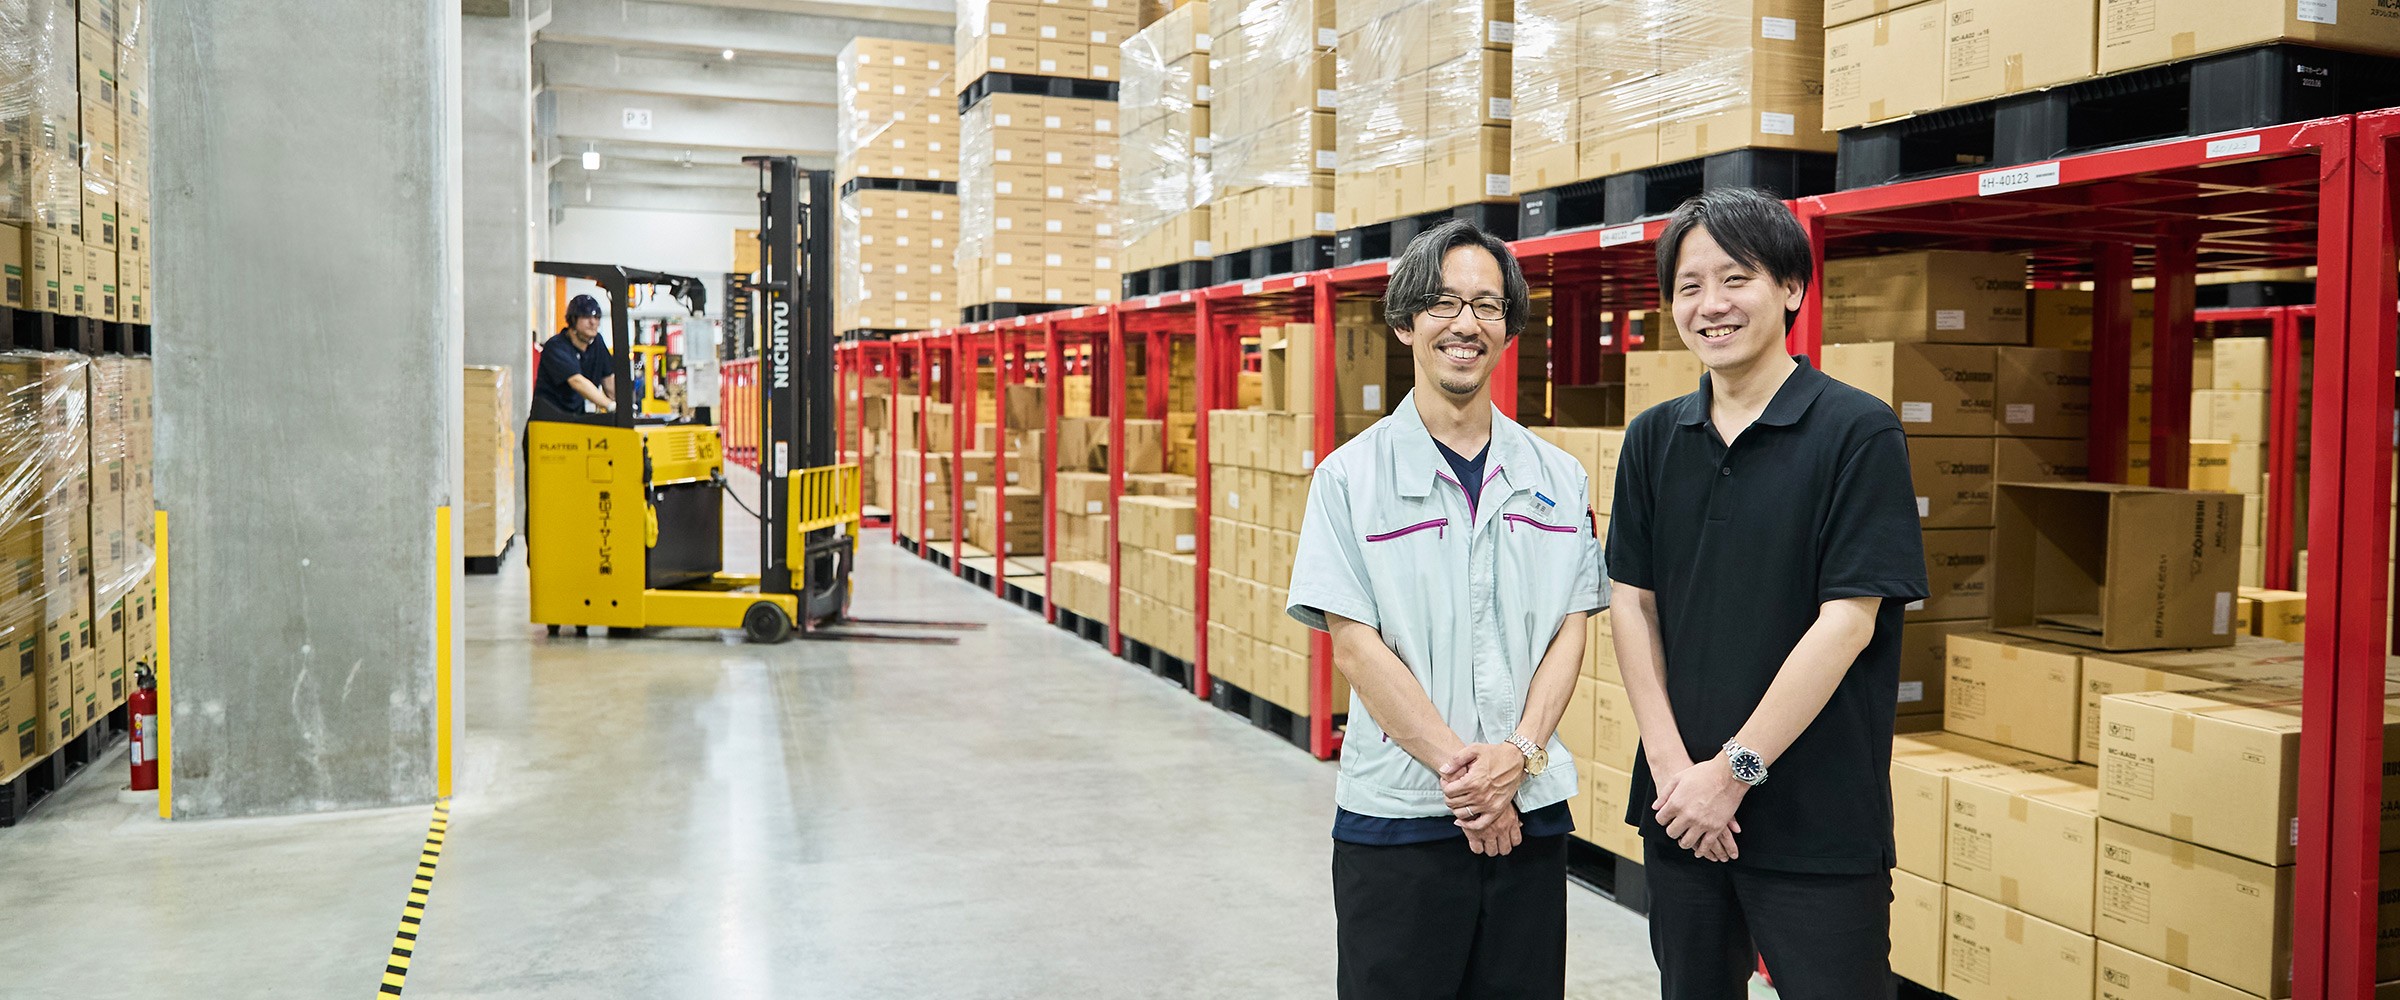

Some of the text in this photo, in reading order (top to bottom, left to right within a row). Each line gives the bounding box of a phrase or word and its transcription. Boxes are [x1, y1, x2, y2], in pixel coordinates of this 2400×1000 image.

[1981, 172, 2029, 189] 4H-40123
[773, 301, 789, 388] NICHIYU
[587, 438, 608, 450] 14
